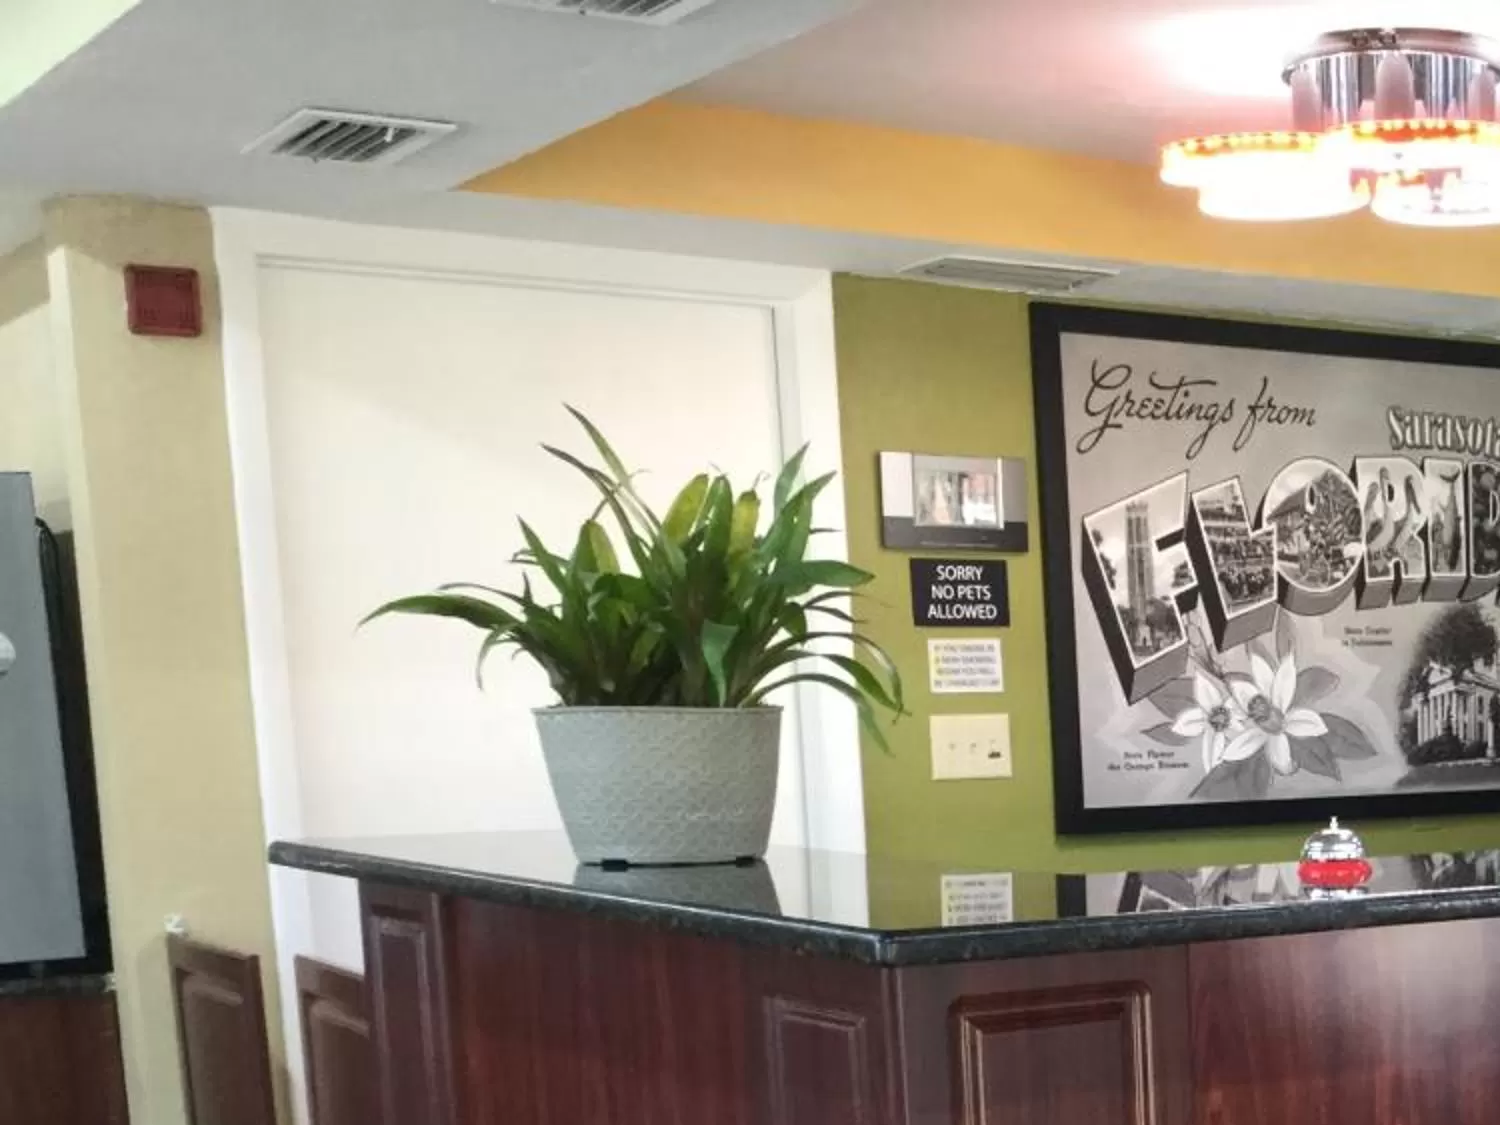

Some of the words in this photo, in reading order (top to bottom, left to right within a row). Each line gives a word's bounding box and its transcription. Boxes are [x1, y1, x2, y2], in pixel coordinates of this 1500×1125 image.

[1076, 359, 1236, 460] Greetings
[1232, 376, 1316, 452] from
[935, 565, 983, 581] SORRY
[931, 584, 955, 600] NO
[957, 585, 992, 600] PETS
[927, 603, 998, 619] ALLOWED
